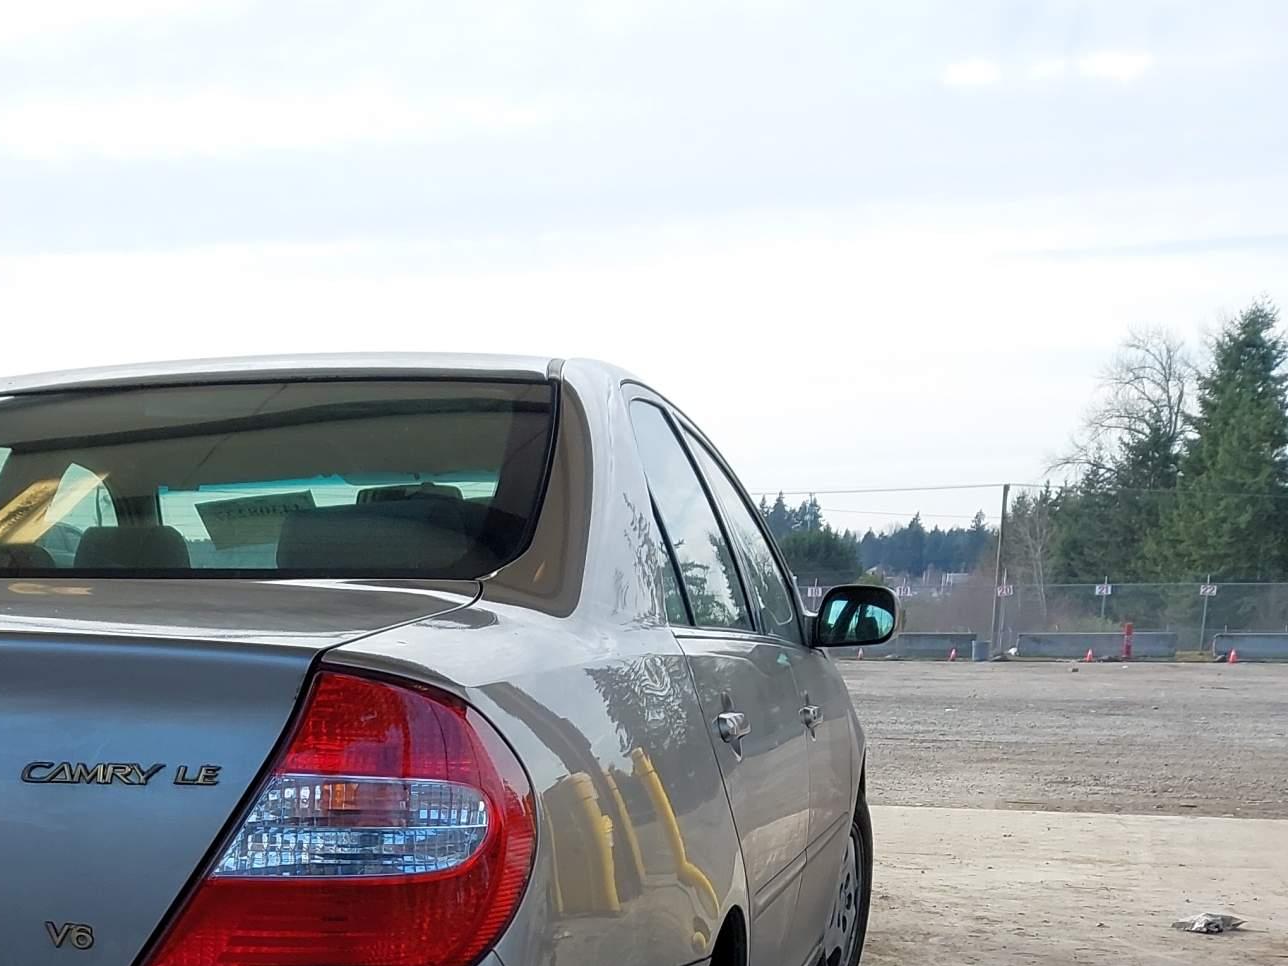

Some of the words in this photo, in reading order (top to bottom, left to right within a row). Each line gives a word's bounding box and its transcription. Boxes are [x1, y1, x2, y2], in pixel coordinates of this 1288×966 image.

[20, 761, 166, 785] CAMRY
[173, 764, 221, 785] LE
[44, 921, 94, 950] V6
